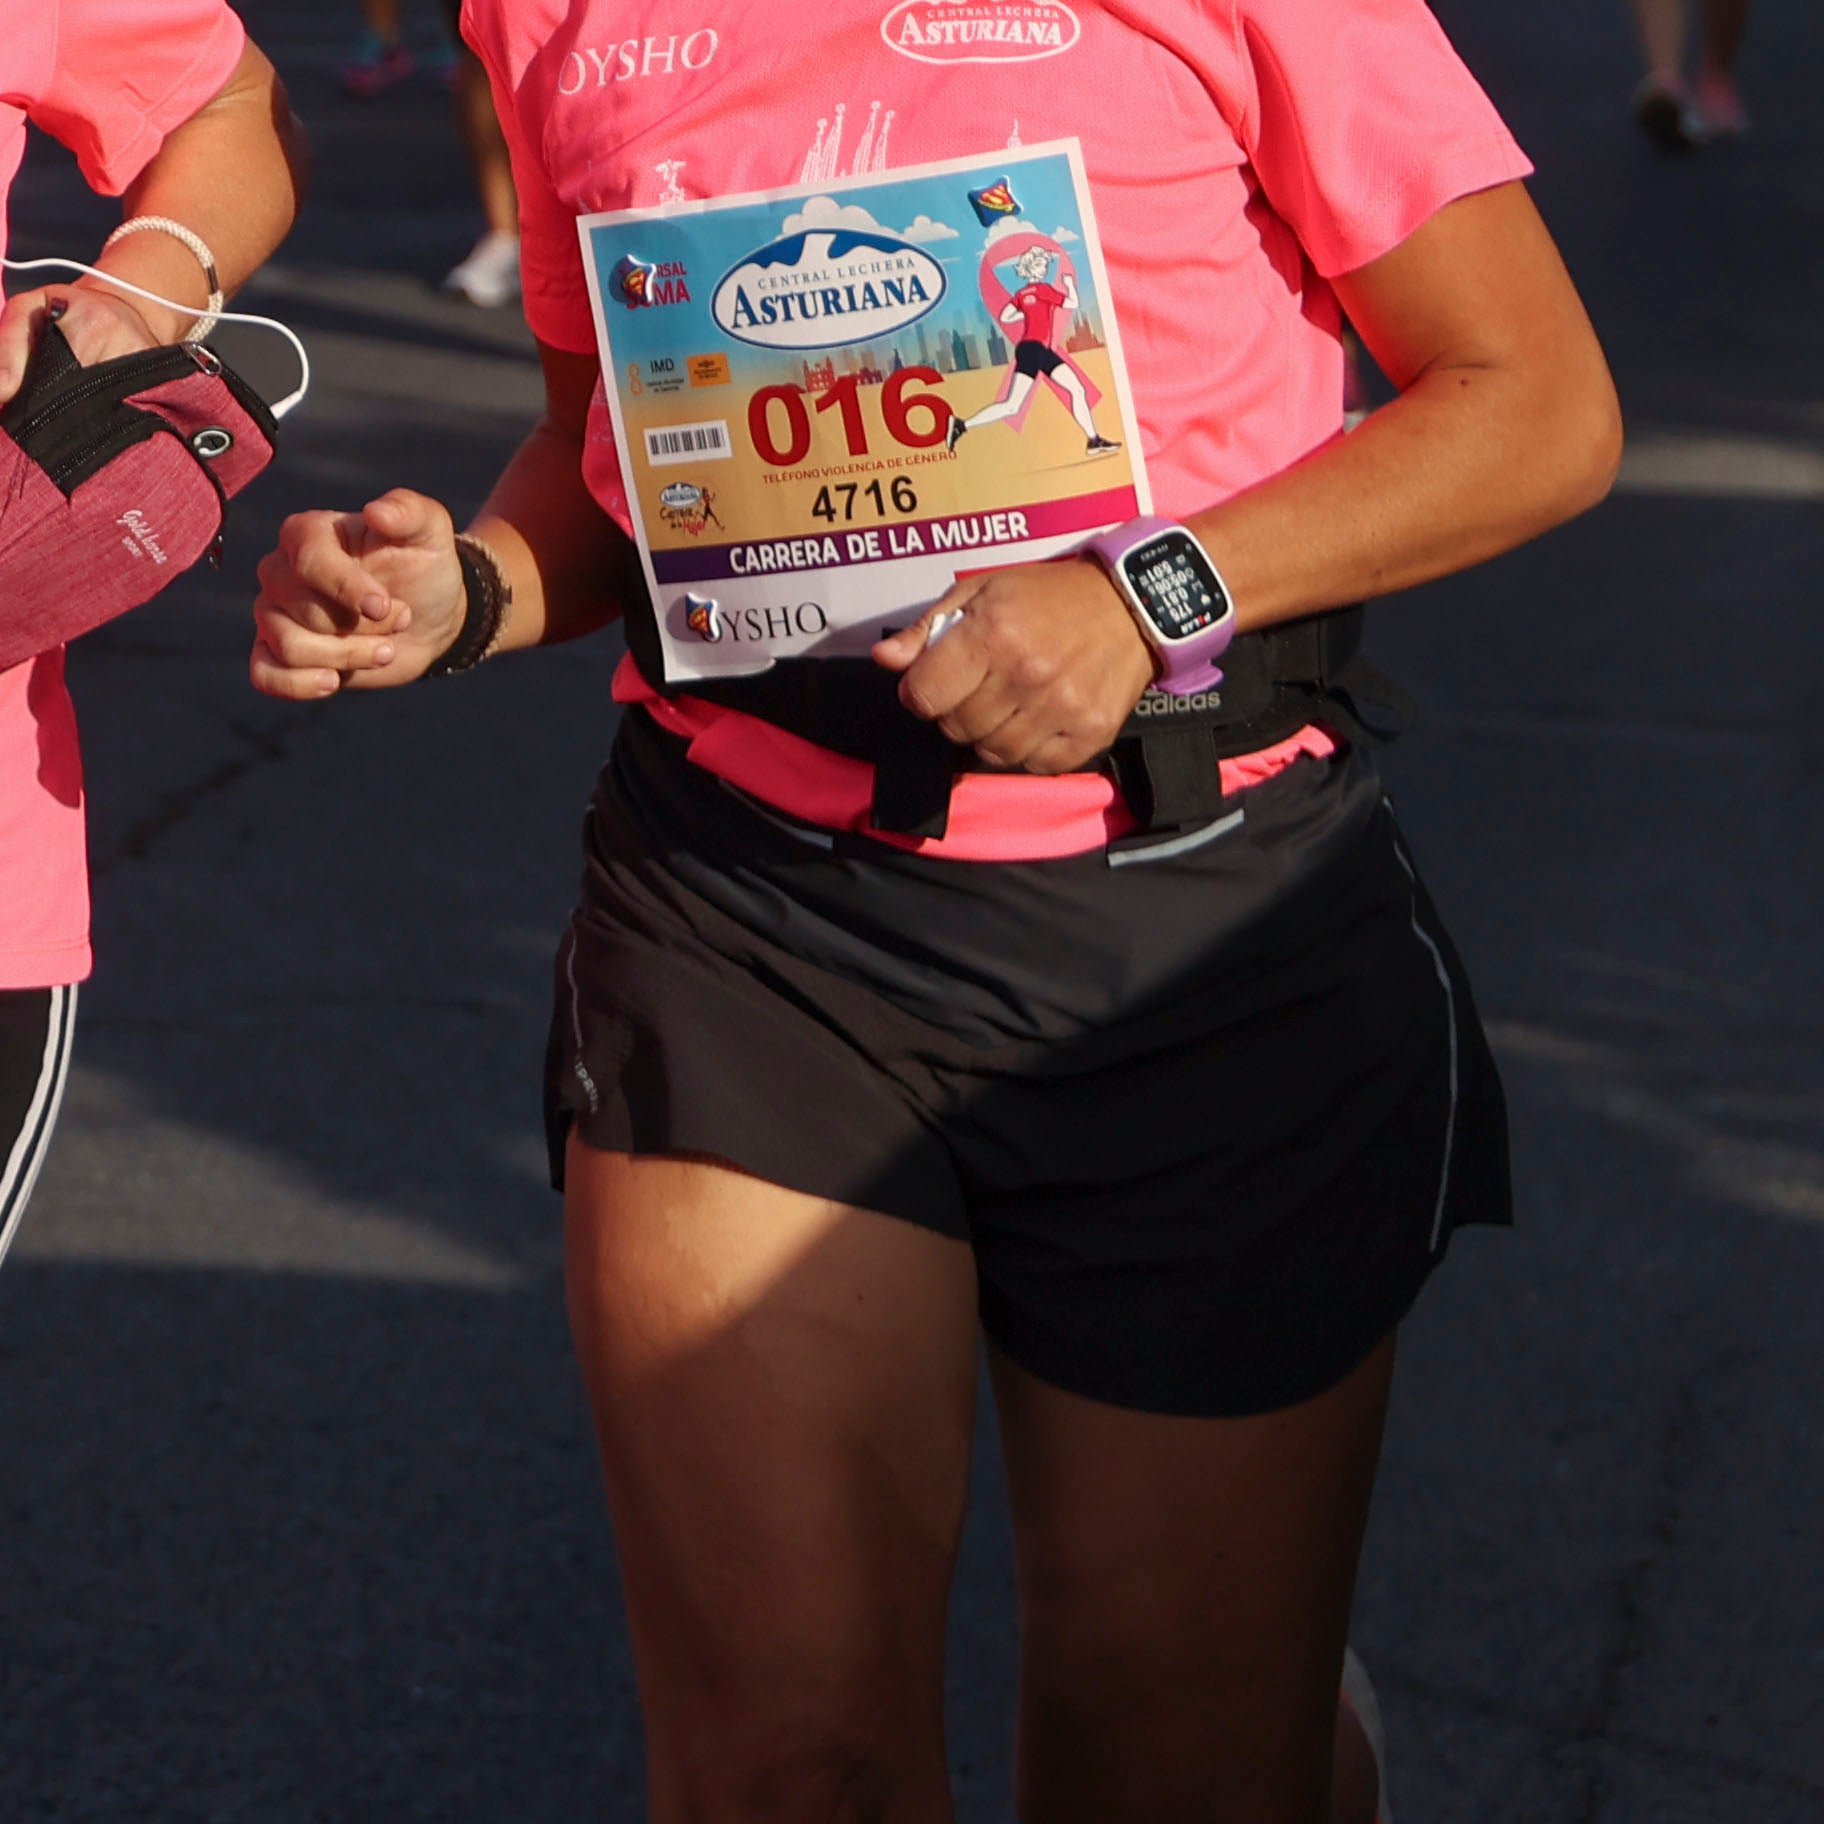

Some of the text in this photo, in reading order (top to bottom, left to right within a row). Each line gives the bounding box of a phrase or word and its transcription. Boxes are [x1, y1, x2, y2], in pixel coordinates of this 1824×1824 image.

[898, 12, 1062, 46] ASTURIANA
[927, 5, 1060, 19] CENTRAL LECHERA
[559, 27, 719, 96] OYSHO
[757, 257, 915, 291] CENTRAL LECHERA
[730, 274, 930, 328] ASTURIANA
[650, 357, 675, 374] IMD
[747, 364, 956, 467] 016
[821, 459, 885, 477] VIOLENCIA
[888, 457, 903, 468] DE
[811, 475, 918, 523] 4716
[729, 511, 1030, 575] CARRERA DE LA MUJER
[702, 601, 827, 643] YSHO
[1135, 691, 1221, 716] adidas
